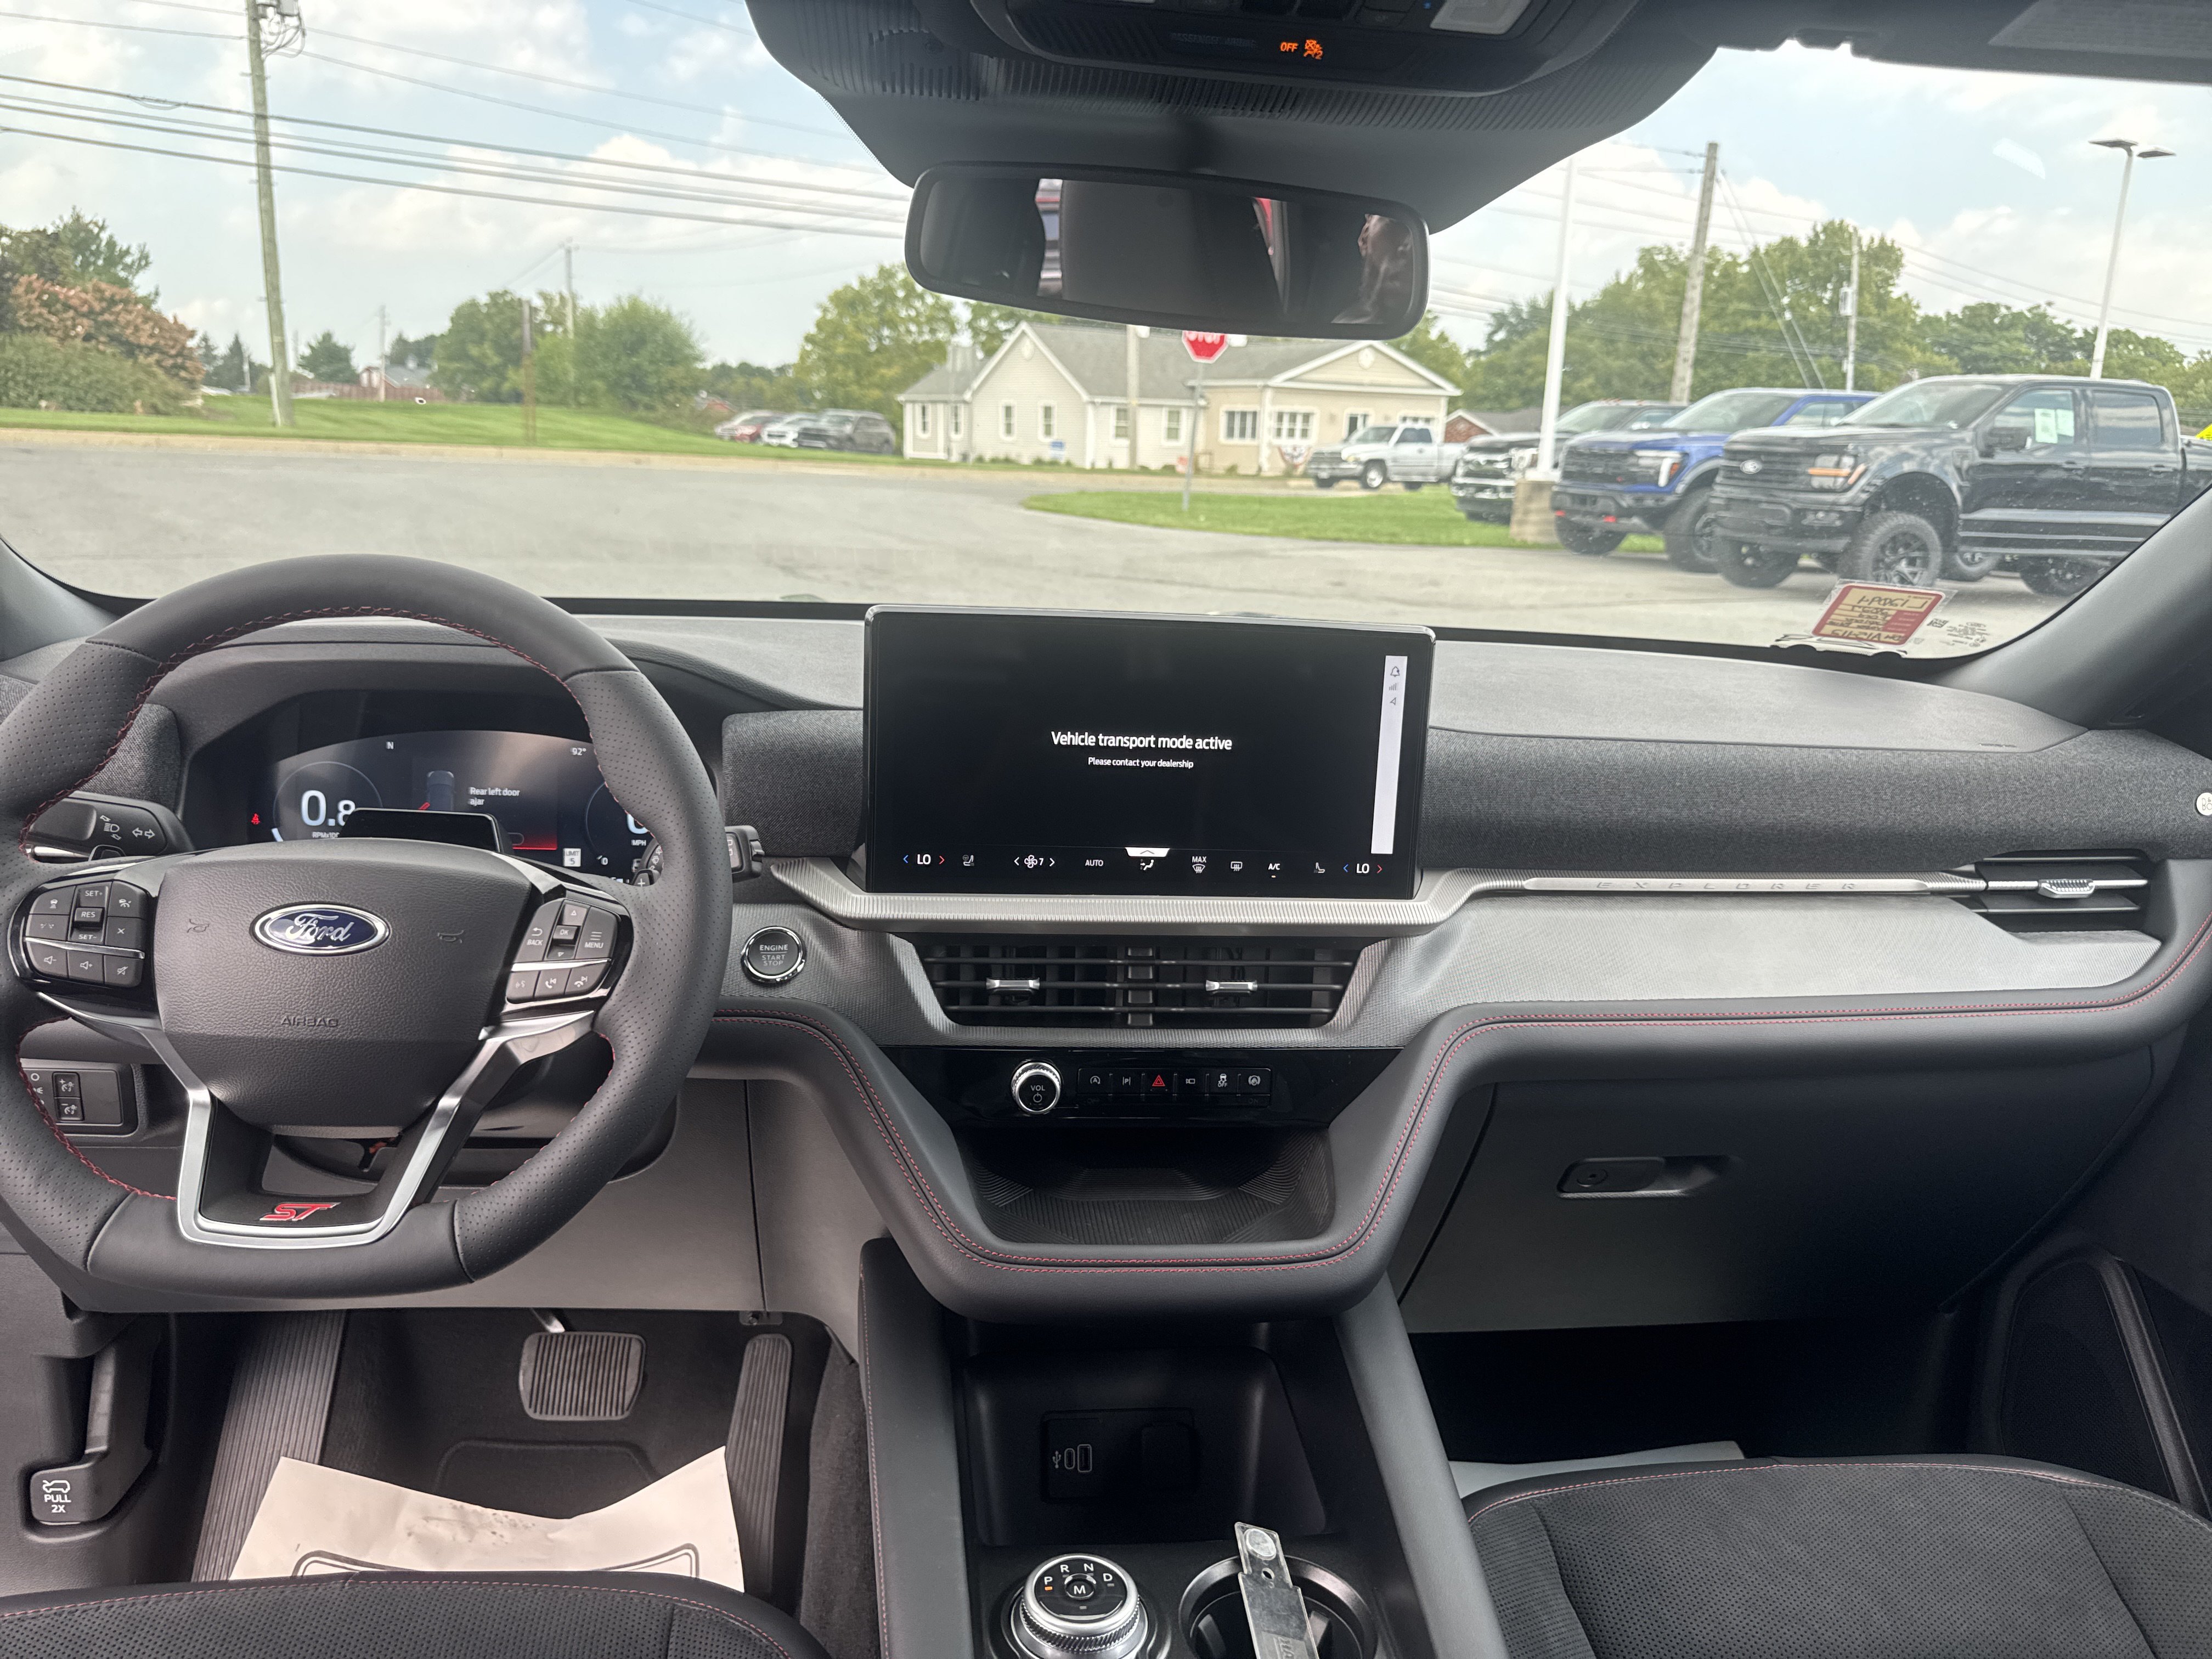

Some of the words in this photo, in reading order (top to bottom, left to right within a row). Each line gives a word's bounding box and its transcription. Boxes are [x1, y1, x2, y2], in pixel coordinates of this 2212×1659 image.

[1280, 42, 1299, 52] OFF
[386, 741, 394, 749] N
[1051, 731, 1096, 746] Vehicle
[1098, 733, 1155, 749] transport
[1158, 735, 1193, 749] mode
[1195, 736, 1232, 750] active
[1088, 757, 1111, 766] Please
[1113, 759, 1139, 767] contact
[1157, 759, 1194, 769] dealership
[470, 787, 487, 795] Rear
[488, 787, 502, 795] left
[503, 788, 520, 796] door
[470, 798, 484, 806] ajar
[917, 854, 932, 865] LO
[1039, 857, 1045, 866] 7
[1356, 864, 1370, 874] LO
[1596, 881, 1856, 890] EXPLORER
[285, 913, 355, 945] Ford
[280, 1016, 340, 1028] AIRBAG
[259, 1202, 342, 1221] ST
[44, 1494, 71, 1503] PULL
[51, 1504, 66, 1513] 2X
[1044, 1576, 1053, 1585] P
[1060, 1564, 1070, 1573] R
[1084, 1563, 1094, 1572] N
[1103, 1573, 1113, 1582] D
[1074, 1585, 1086, 1594] M
